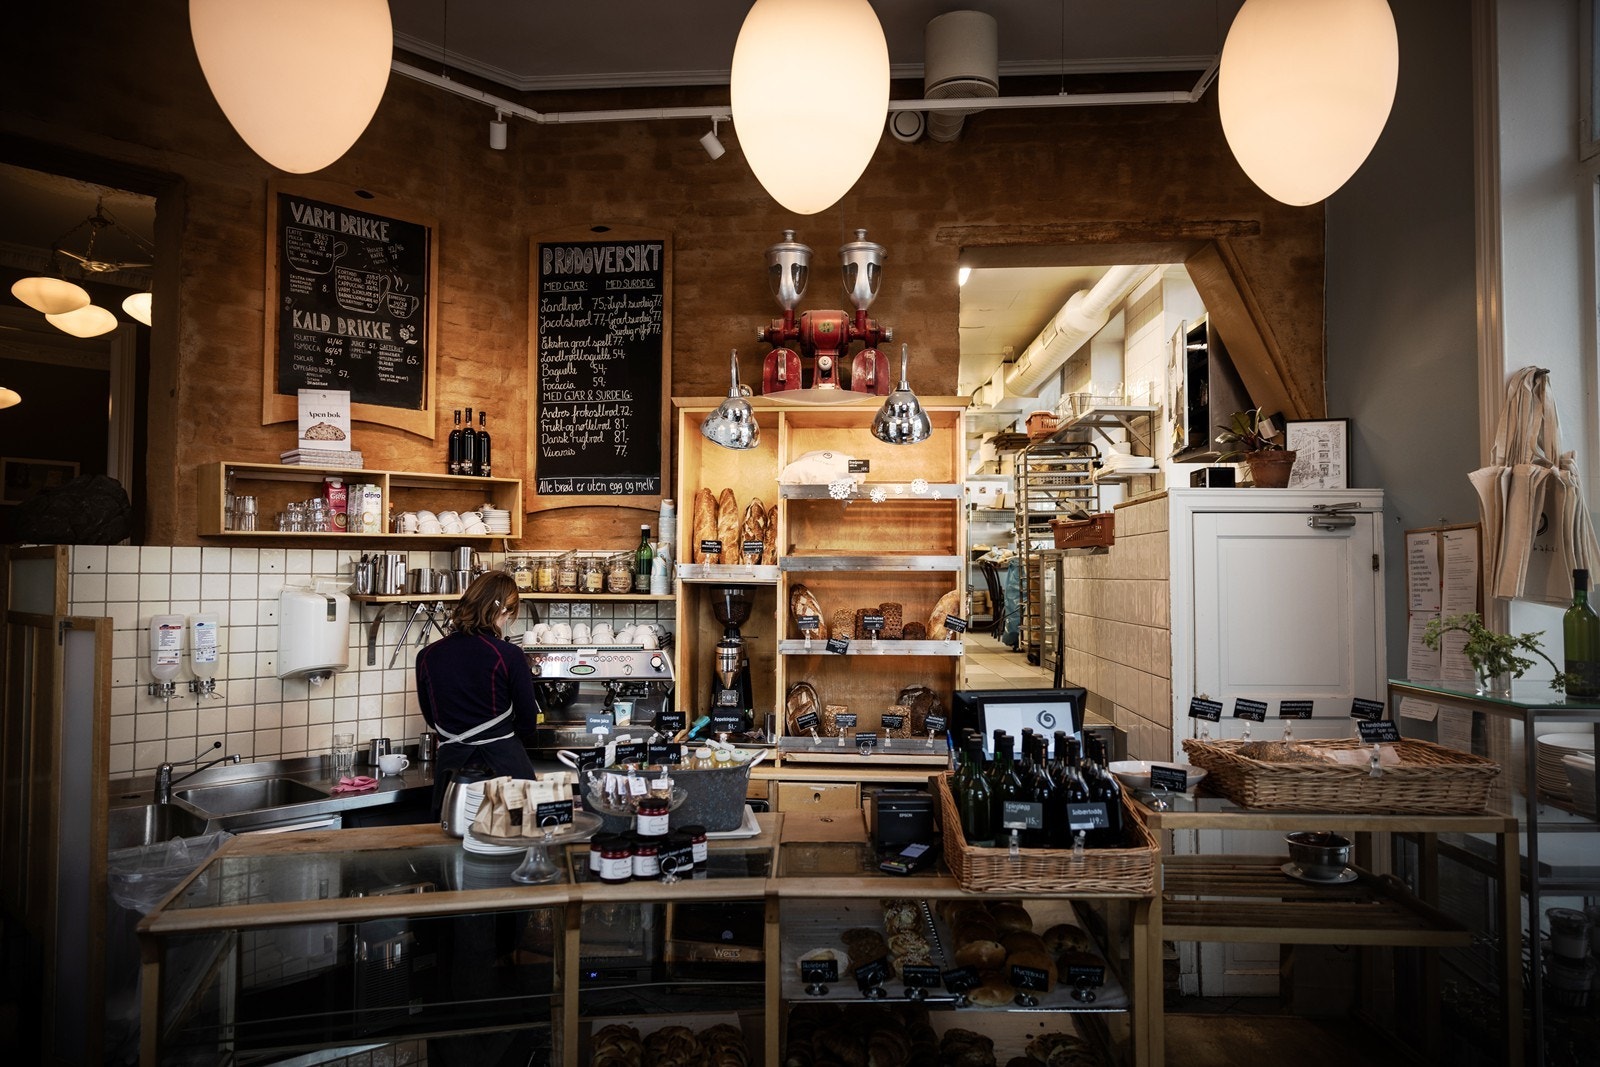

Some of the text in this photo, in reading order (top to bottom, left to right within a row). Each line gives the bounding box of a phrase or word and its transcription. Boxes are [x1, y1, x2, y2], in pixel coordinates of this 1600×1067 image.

[290, 201, 335, 229] VARM
[542, 244, 662, 275] BRØDOVERSIKT
[543, 282, 562, 291] MED
[605, 280, 622, 289] MED
[540, 296, 584, 313] Landbrød
[292, 309, 330, 332] KALD
[293, 333, 317, 343] ISLATTE
[351, 340, 366, 348] JUICE
[541, 335, 570, 350] Ekstra
[293, 342, 321, 352] ISMOCCA
[293, 354, 314, 362] ISKLAR
[541, 363, 578, 382] Baguette
[542, 378, 576, 391] Focaccia
[543, 392, 562, 401] MED
[563, 391, 586, 401] GJÆR
[587, 390, 594, 401] &
[541, 432, 569, 445] Dansk
[571, 431, 605, 450] rugbrød
[538, 478, 654, 494] Alle brød er uten egg og melk
[364, 491, 381, 500] alpro
